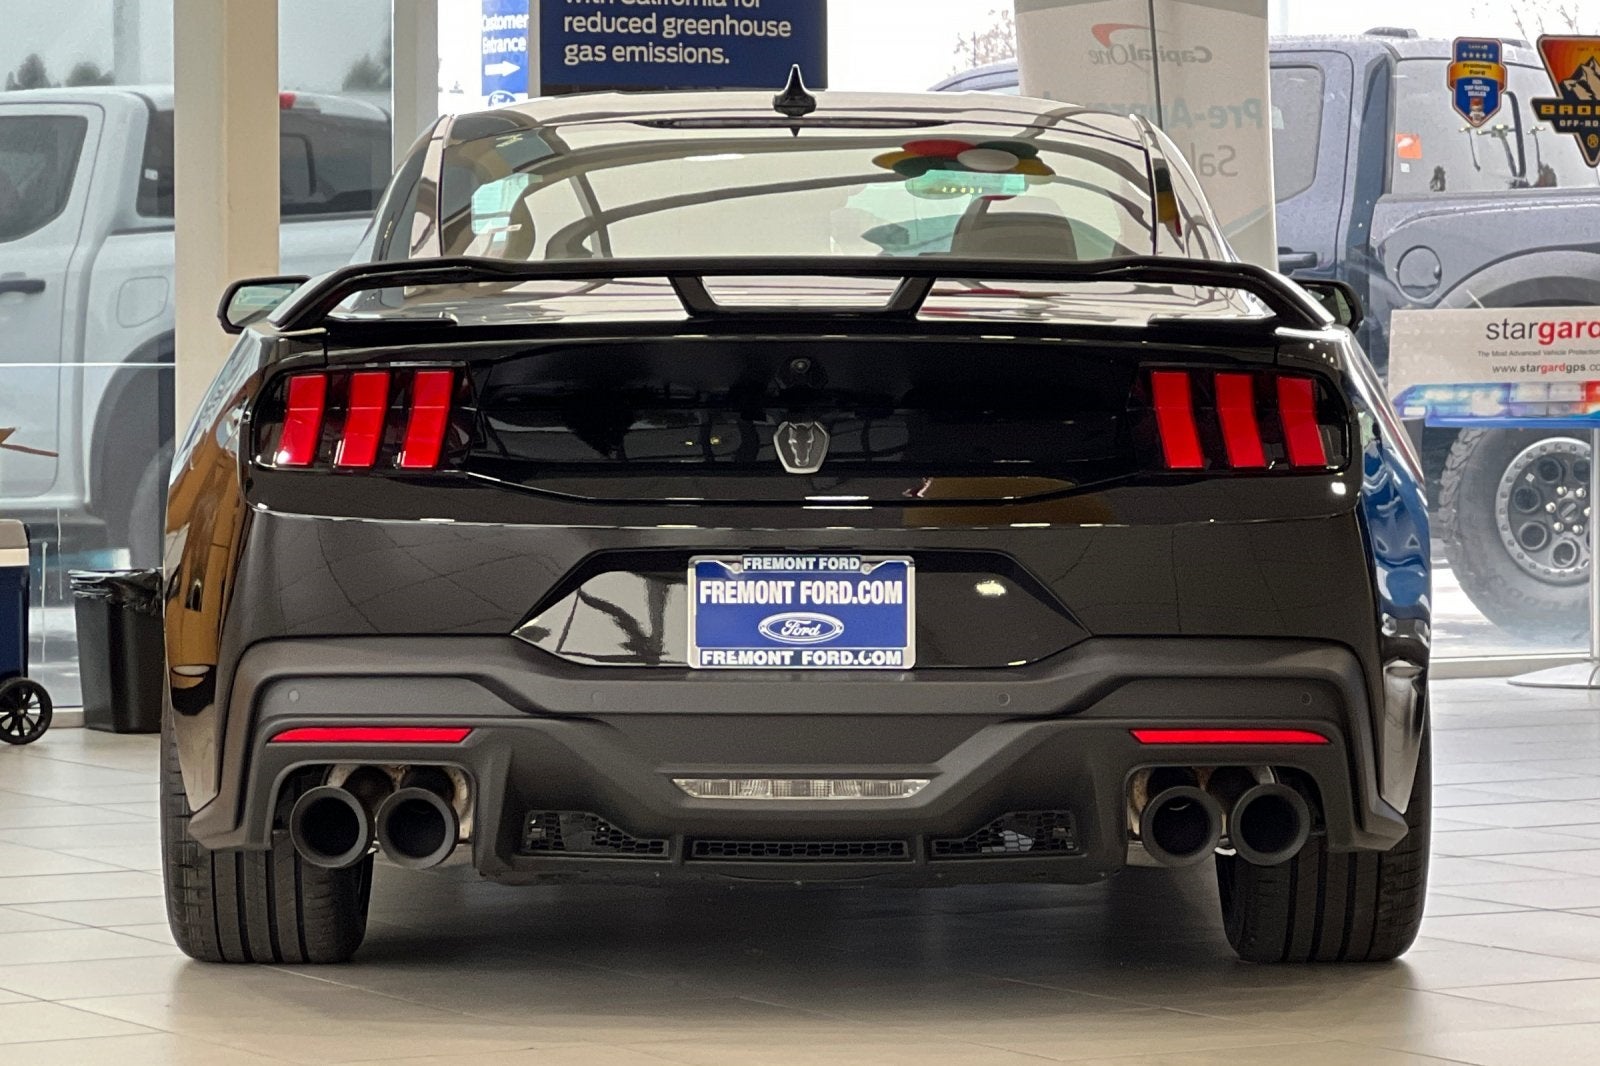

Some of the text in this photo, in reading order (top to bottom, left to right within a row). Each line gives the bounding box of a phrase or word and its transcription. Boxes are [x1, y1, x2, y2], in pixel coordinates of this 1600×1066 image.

[563, 11, 792, 38] reduced greenhouse
[482, 37, 527, 54] Entrance
[564, 42, 730, 66] gas emissions.
[743, 557, 860, 570] FREMONT FORD
[700, 580, 903, 604] FREMONT FORD.COM
[780, 620, 821, 636] Ford
[702, 650, 901, 665] FREMONT FORD.COM
